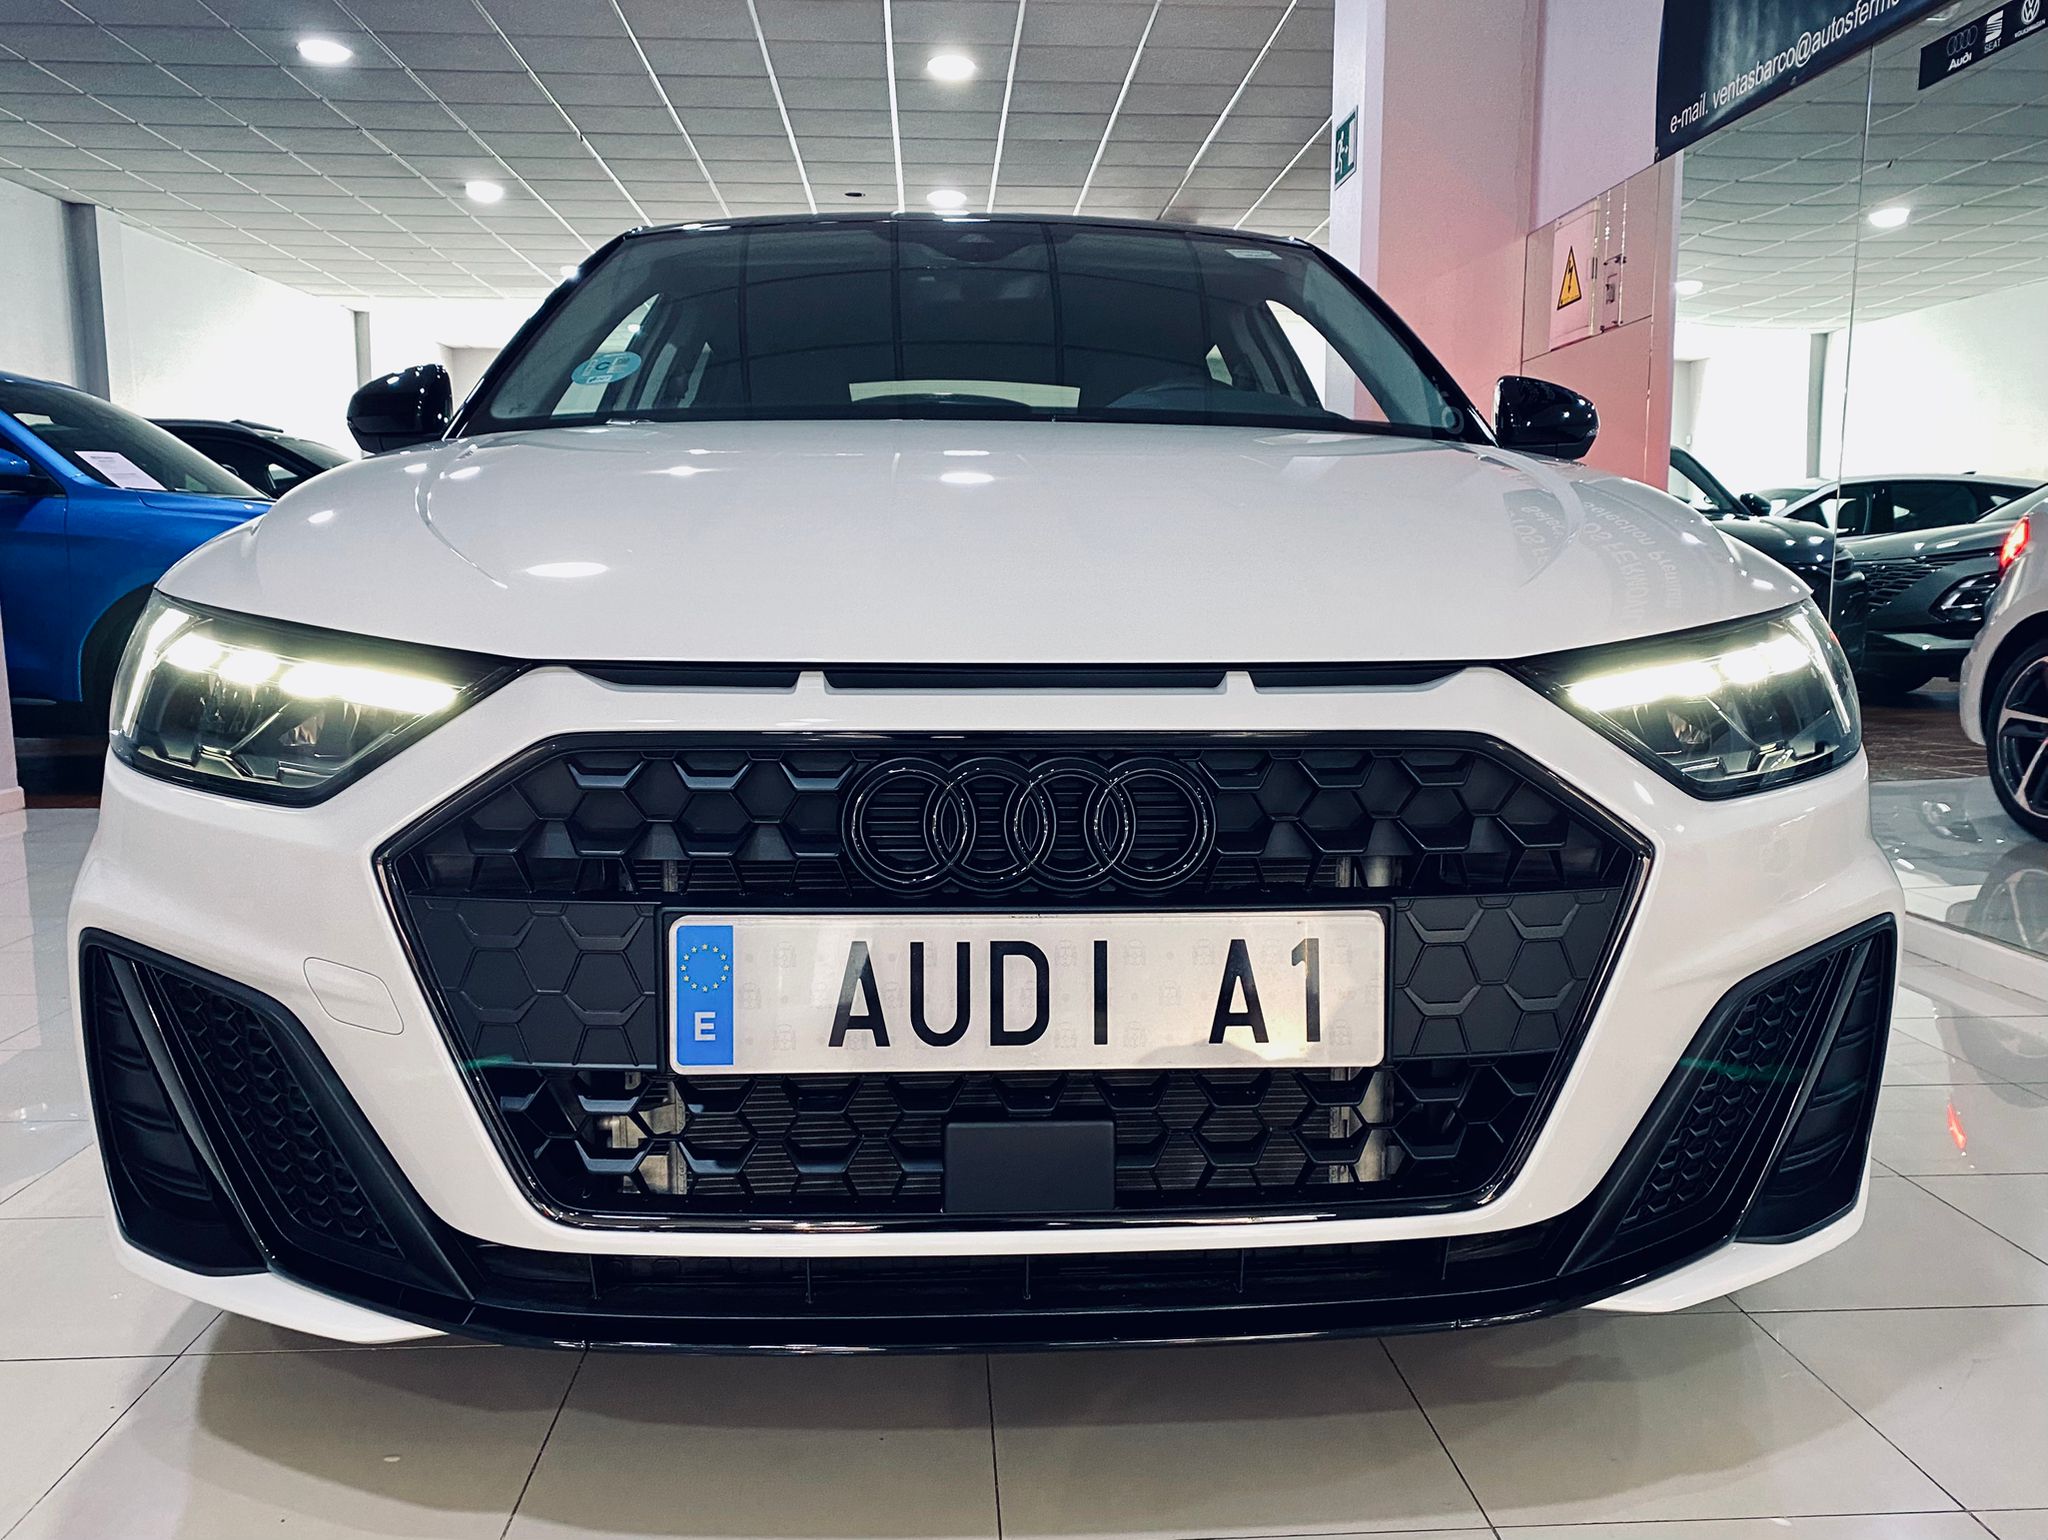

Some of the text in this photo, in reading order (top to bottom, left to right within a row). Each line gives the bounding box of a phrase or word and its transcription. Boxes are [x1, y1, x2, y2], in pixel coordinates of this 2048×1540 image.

[1984, 37, 2002, 54] SEAT
[1947, 52, 1972, 72] Audi
[1669, 91, 1709, 134] e-mail.
[828, 937, 1320, 1047] AUDI A1
[694, 1011, 716, 1042] E
